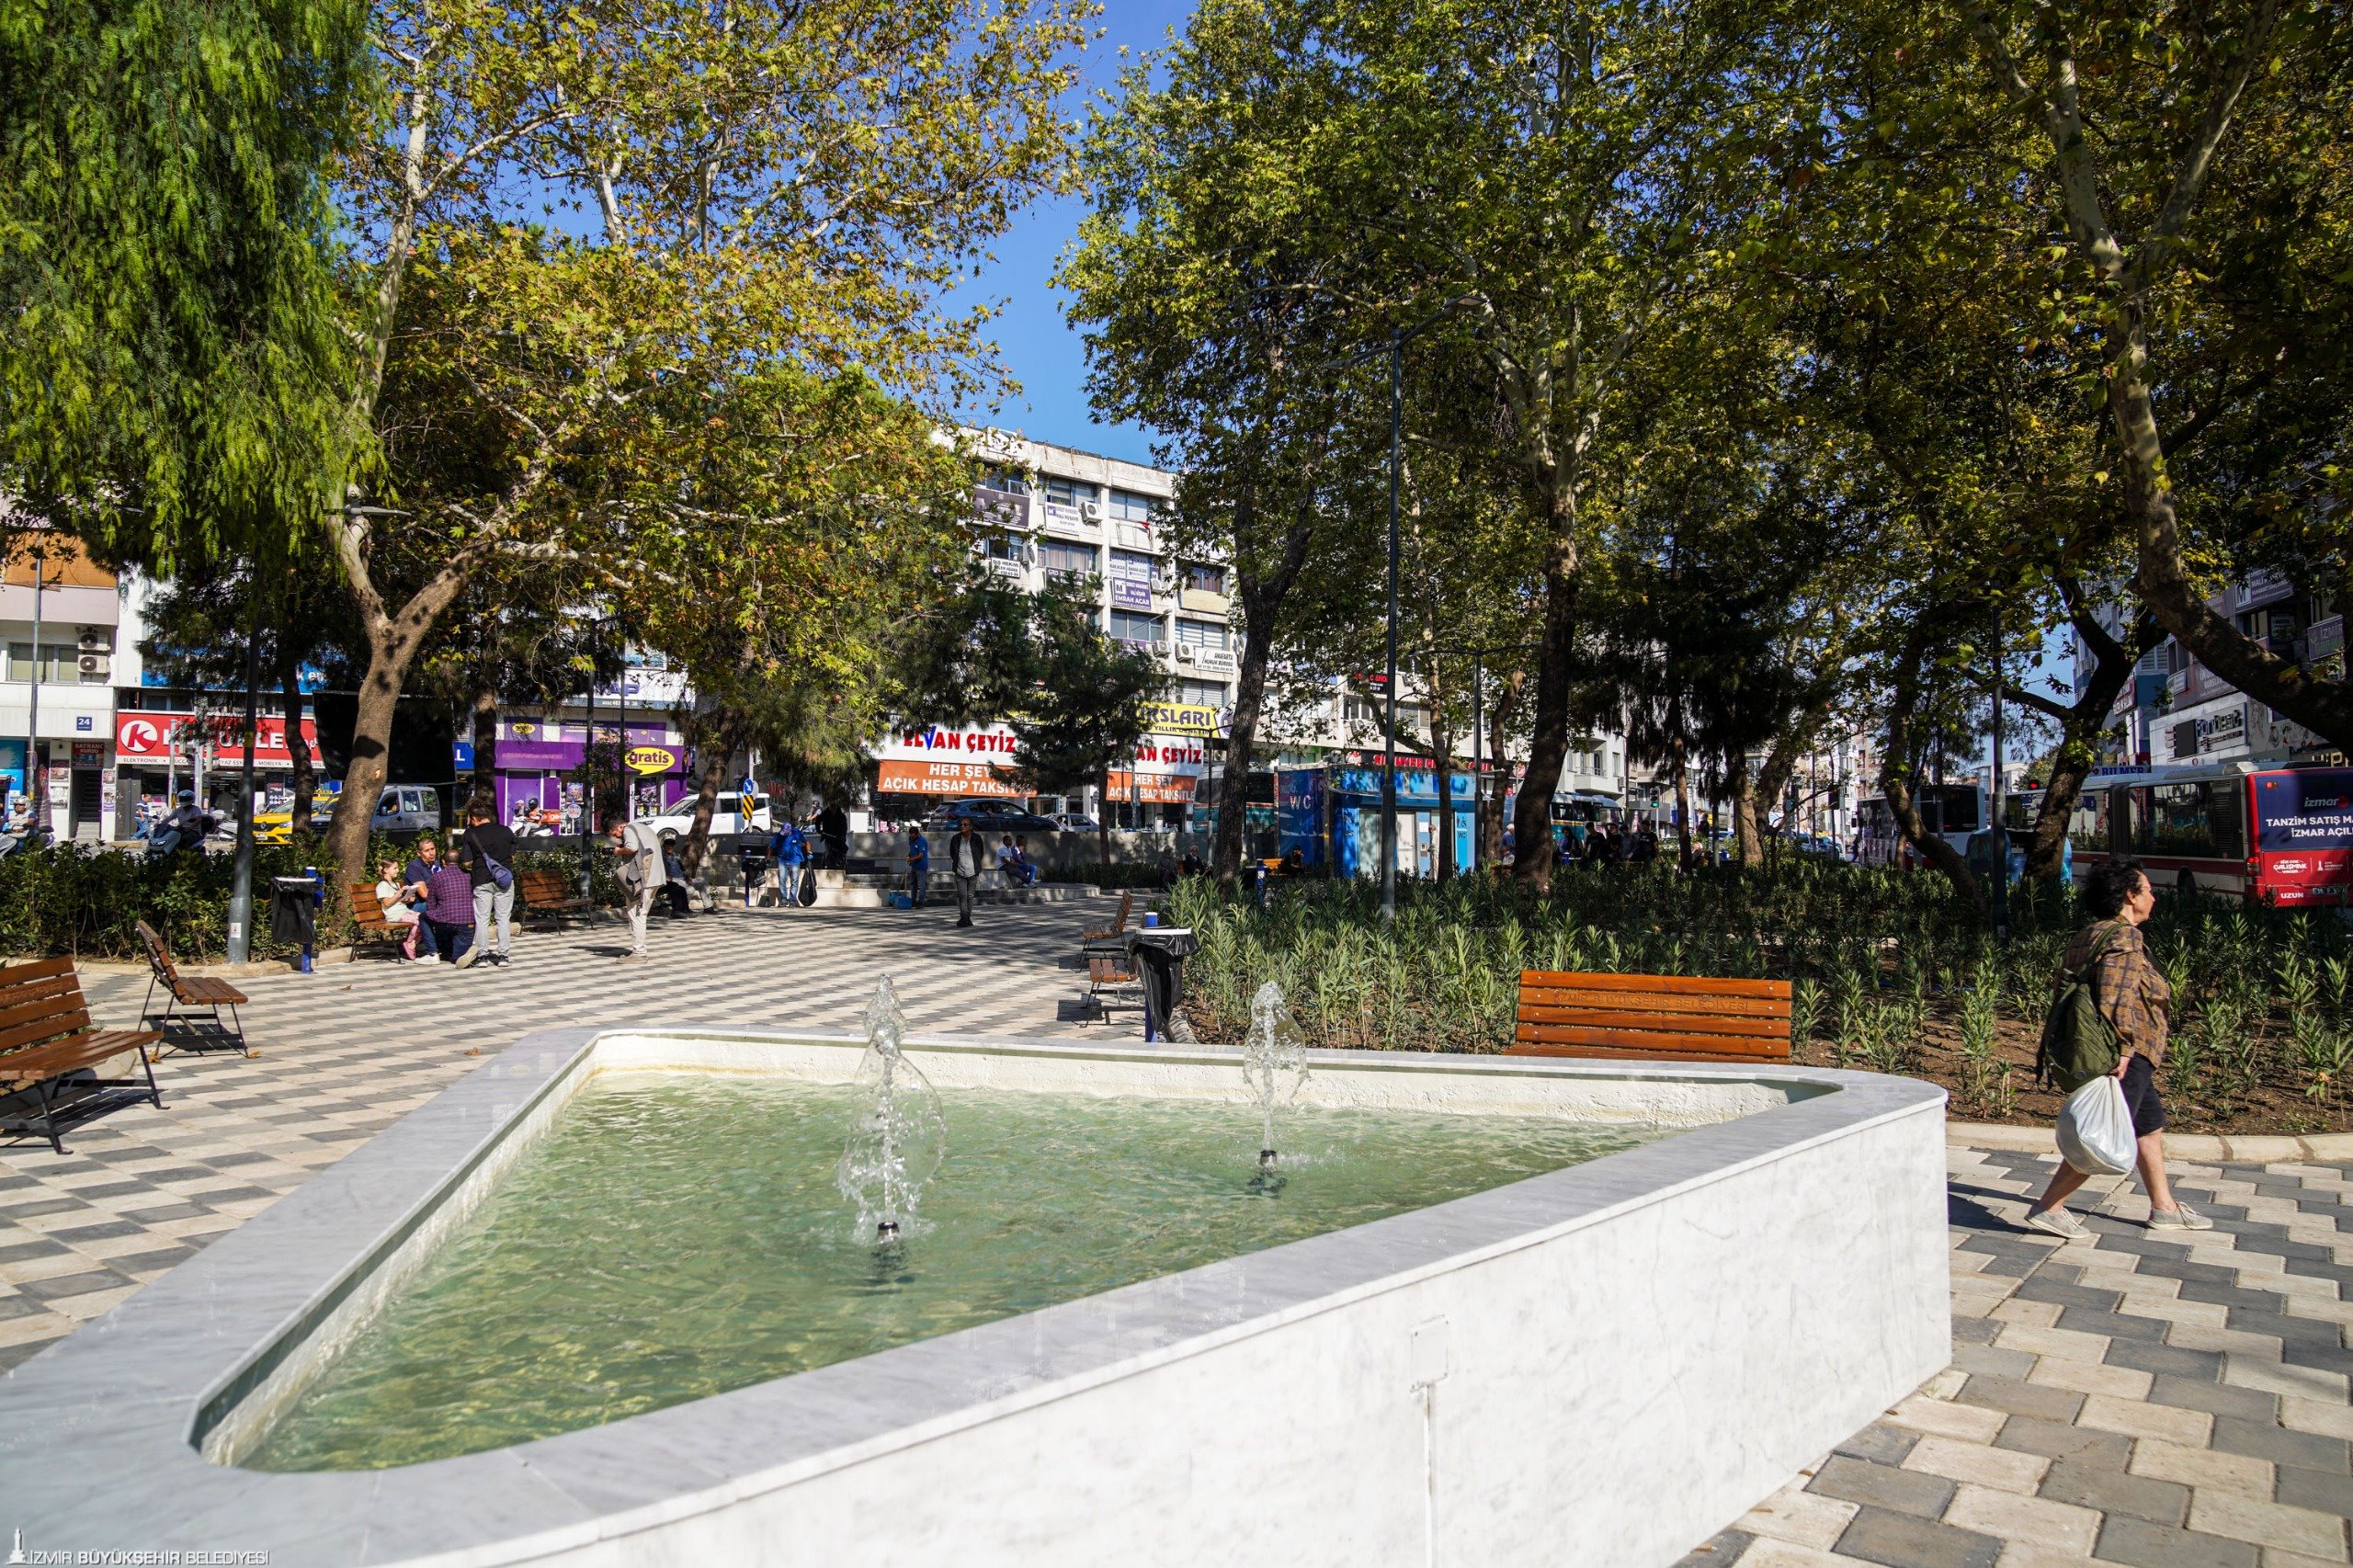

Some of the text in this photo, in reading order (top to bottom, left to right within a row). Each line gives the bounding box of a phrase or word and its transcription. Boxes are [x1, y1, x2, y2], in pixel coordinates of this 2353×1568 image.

[1115, 595, 1134, 603] EMRAH
[1134, 597, 1150, 606] ACAR
[904, 725, 1016, 753] ELVAN ÇEYİZ
[630, 751, 669, 764] gratis
[1162, 744, 1202, 765] ÇEYİZ
[929, 764, 991, 779] HER ŞEY
[883, 777, 918, 791] AÇIK
[922, 779, 968, 792] HESAP
[1135, 774, 1154, 785] HER
[1109, 787, 1131, 799] AÇK
[1140, 788, 1158, 799] ESAP
[1290, 795, 1312, 810] WC
[2266, 815, 2307, 827] TANZİM
[2309, 815, 2341, 825] SATIŞ
[2290, 827, 2325, 837] İZMAR
